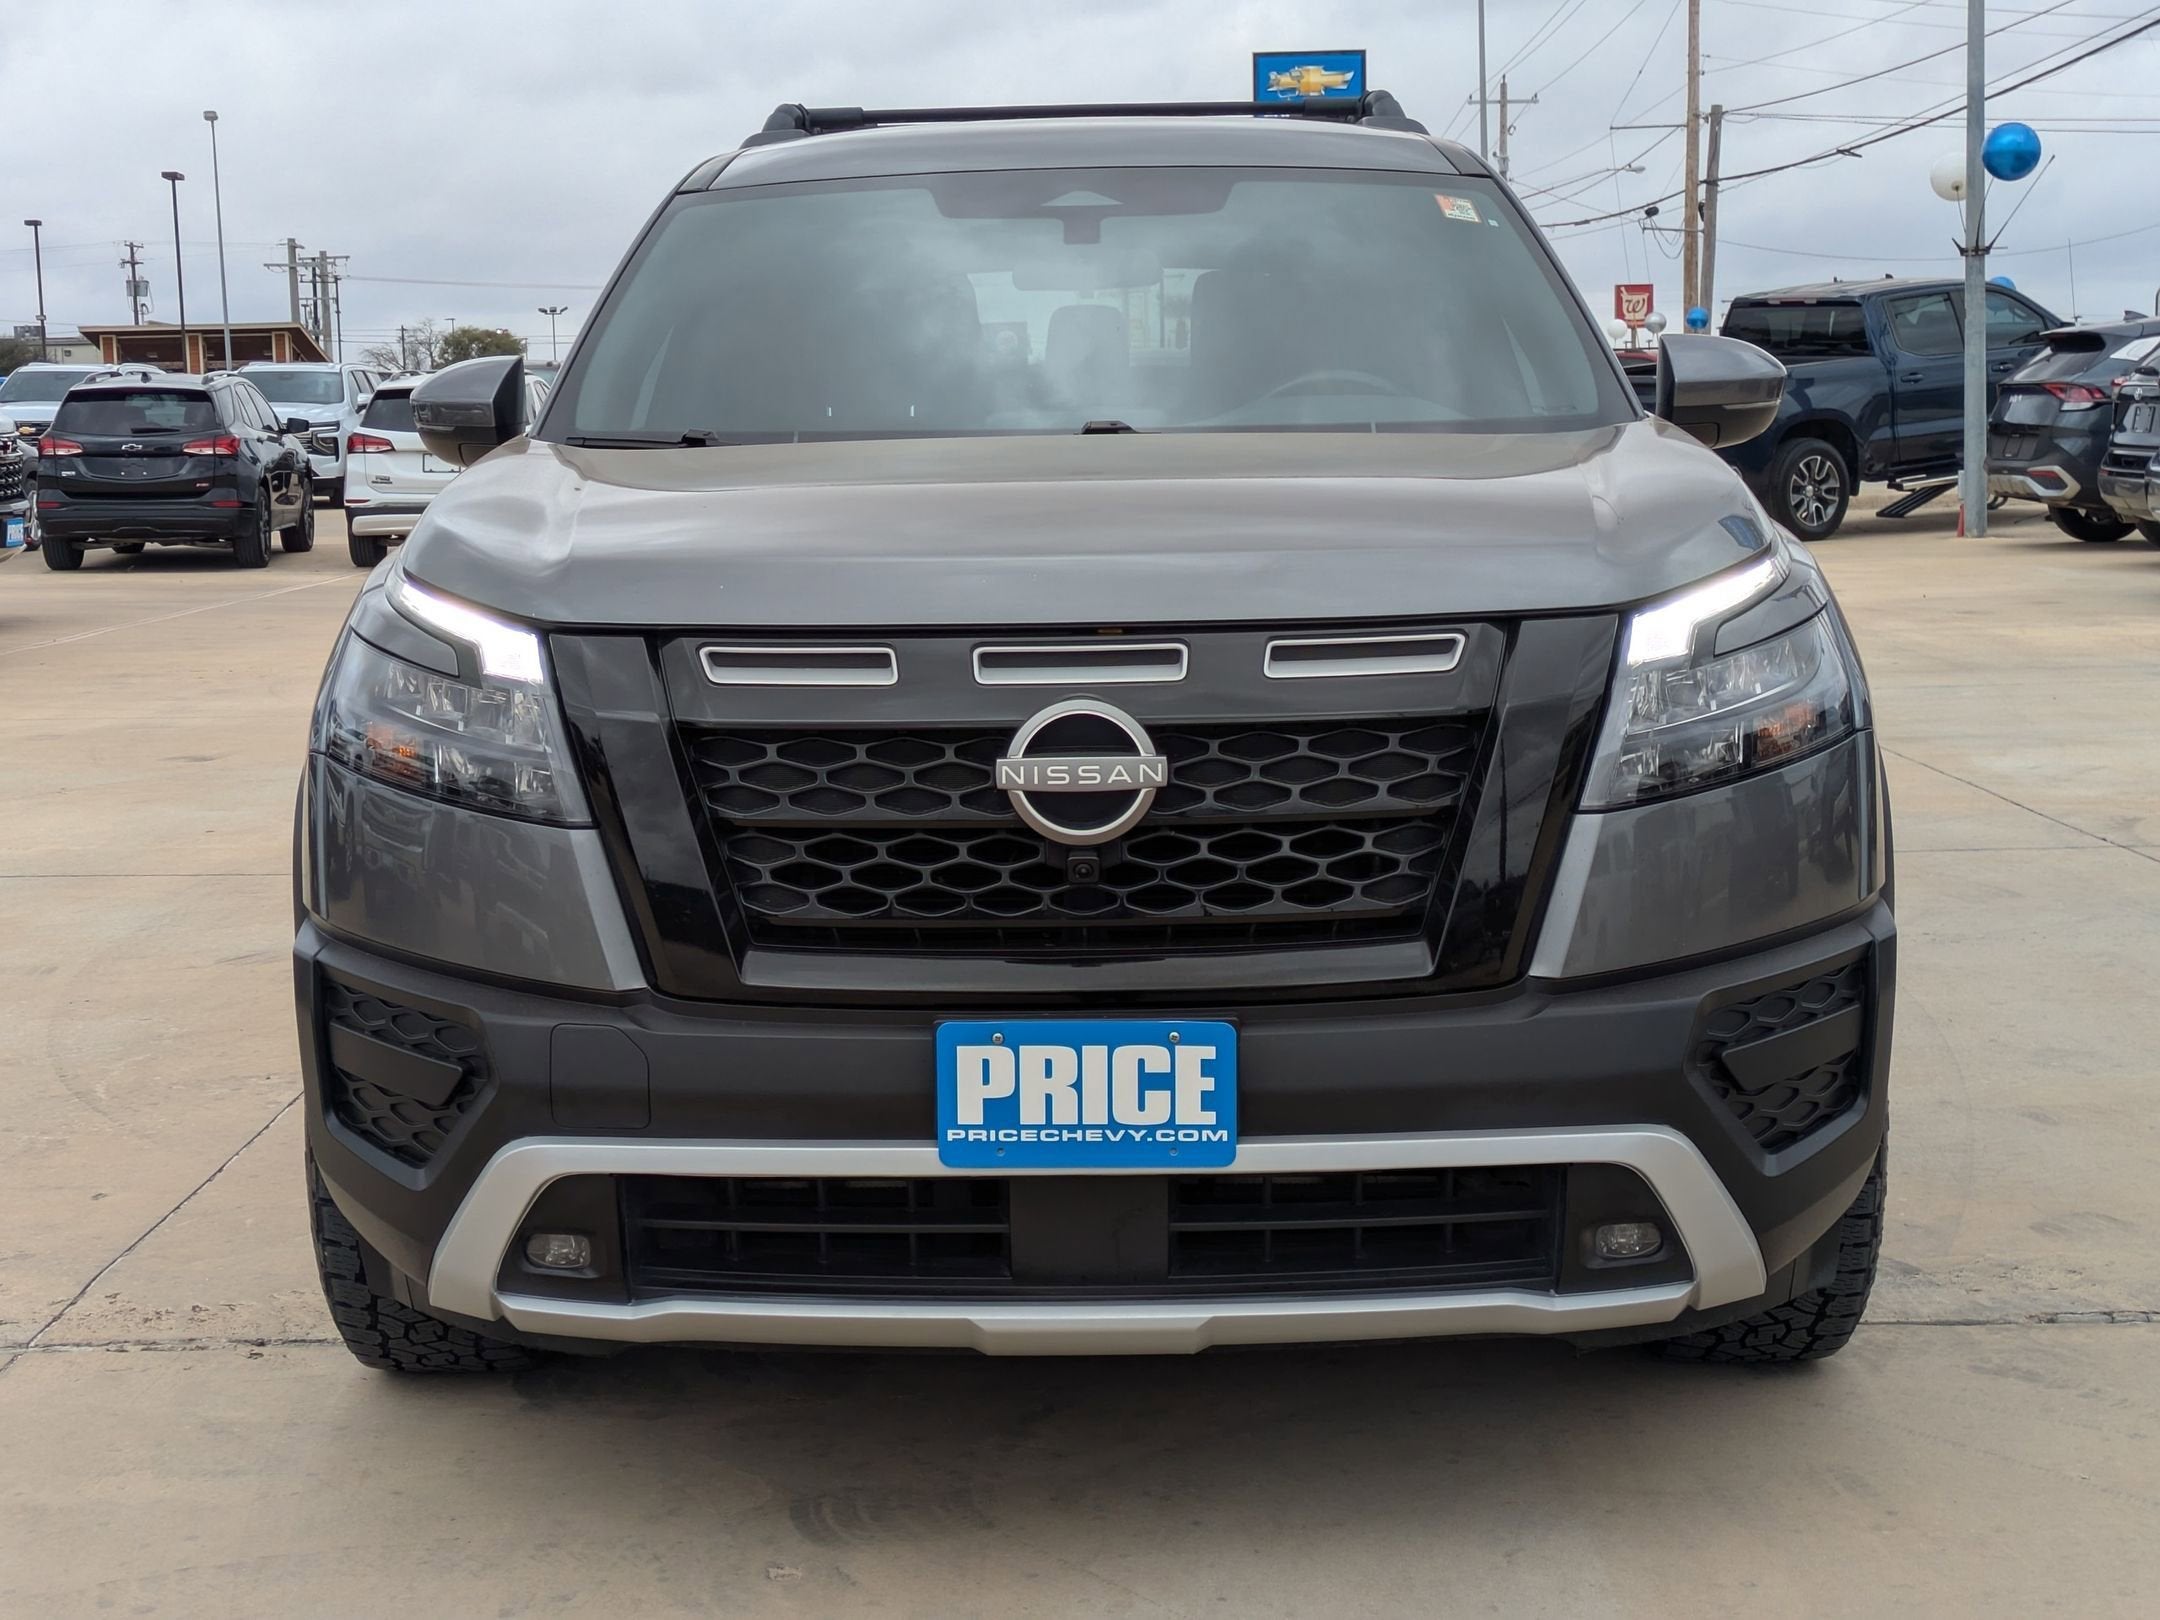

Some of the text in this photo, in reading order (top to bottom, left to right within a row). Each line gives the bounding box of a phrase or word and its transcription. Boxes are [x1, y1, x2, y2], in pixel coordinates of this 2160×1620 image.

[1001, 762, 1163, 785] NISSAN
[956, 1045, 1217, 1126] PRICE
[947, 1128, 1229, 1143] PRICECHEVY.COM
